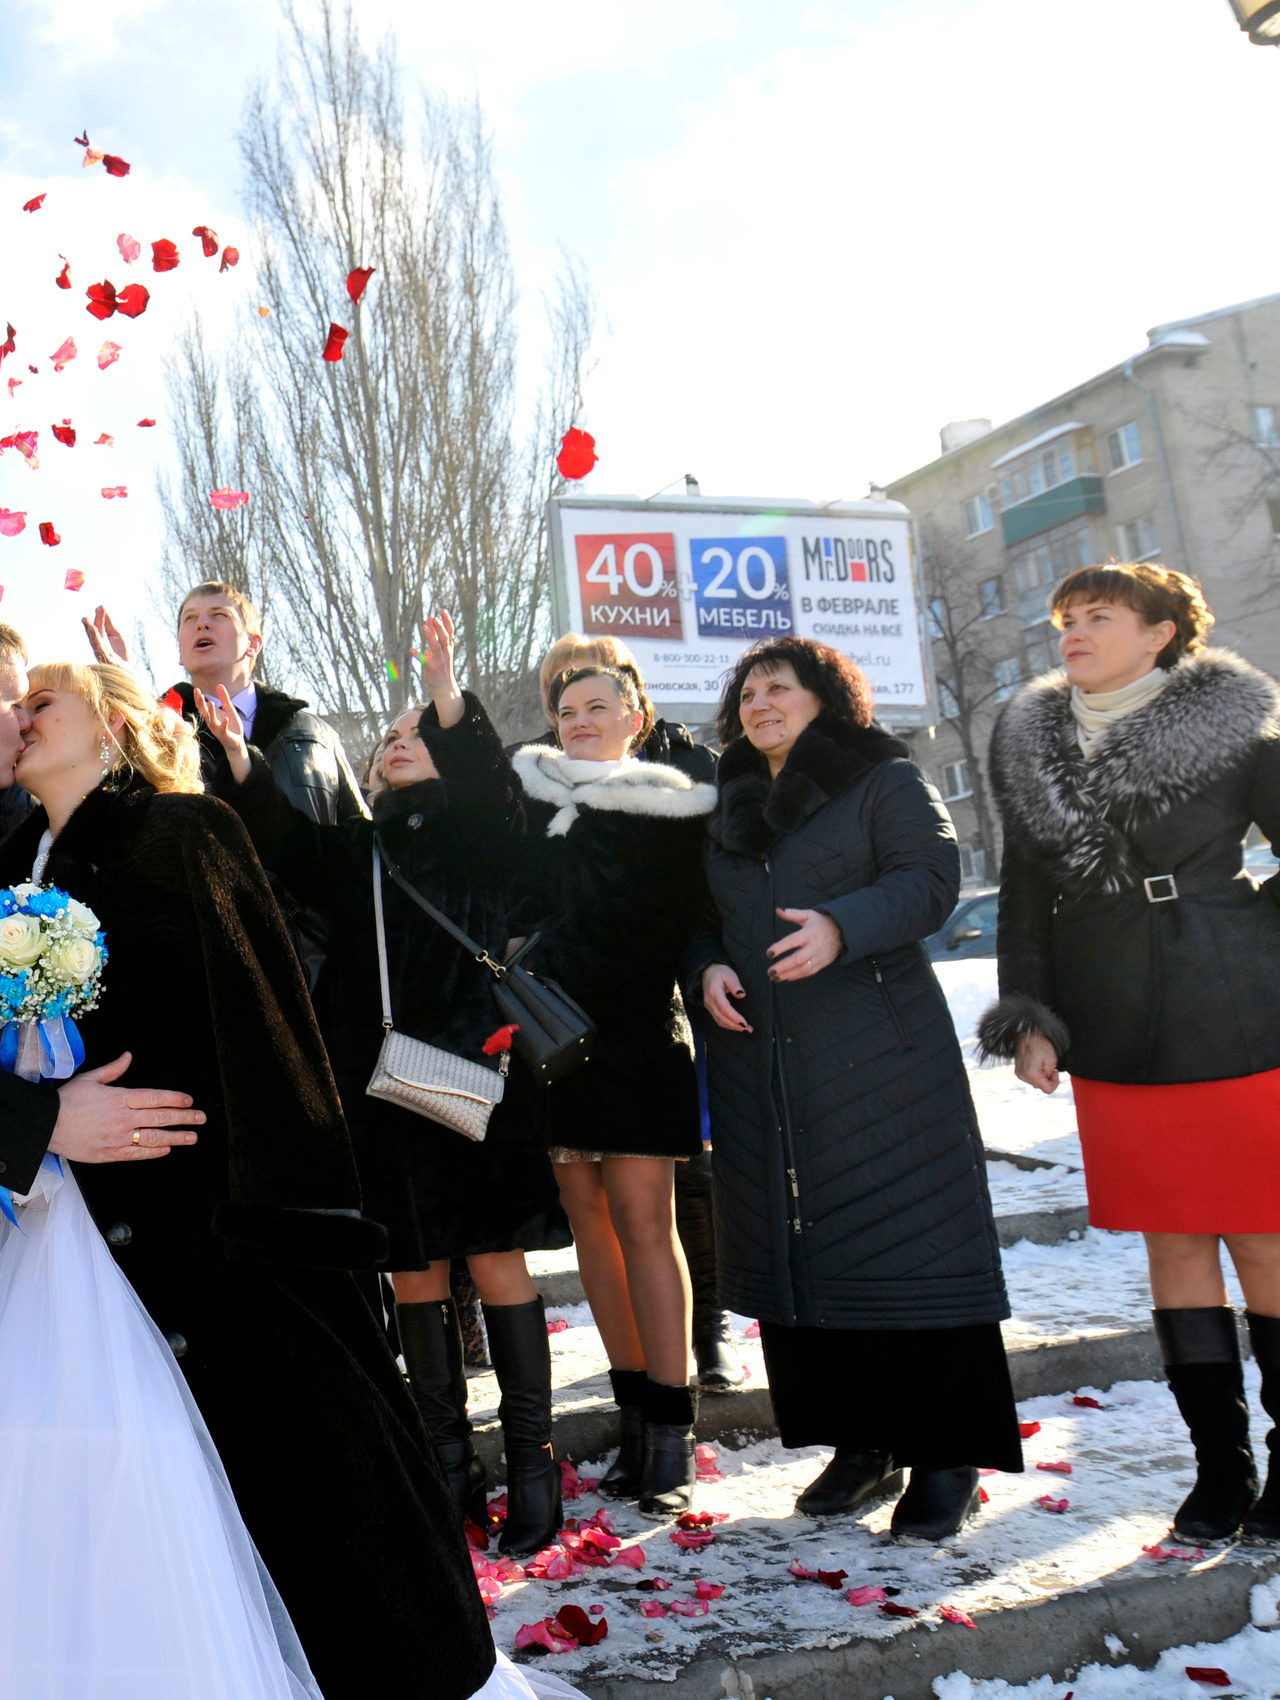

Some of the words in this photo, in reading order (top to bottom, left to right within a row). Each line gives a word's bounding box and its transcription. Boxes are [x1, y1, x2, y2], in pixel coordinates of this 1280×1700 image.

[585, 542, 678, 598] 40%
[700, 546, 790, 600] 20%
[801, 597, 813, 613] В
[817, 597, 900, 615] ФЕВРАЛЕ
[590, 604, 670, 627] КУХНИ
[699, 607, 792, 630] МЕБЕЛЬ
[812, 622, 860, 636] СКИДКА
[863, 624, 879, 636] НА
[653, 653, 729, 664] 8-800-500-22-11
[644, 682, 701, 692] оновская,
[704, 680, 719, 691] 30
[894, 682, 915, 695] 177
